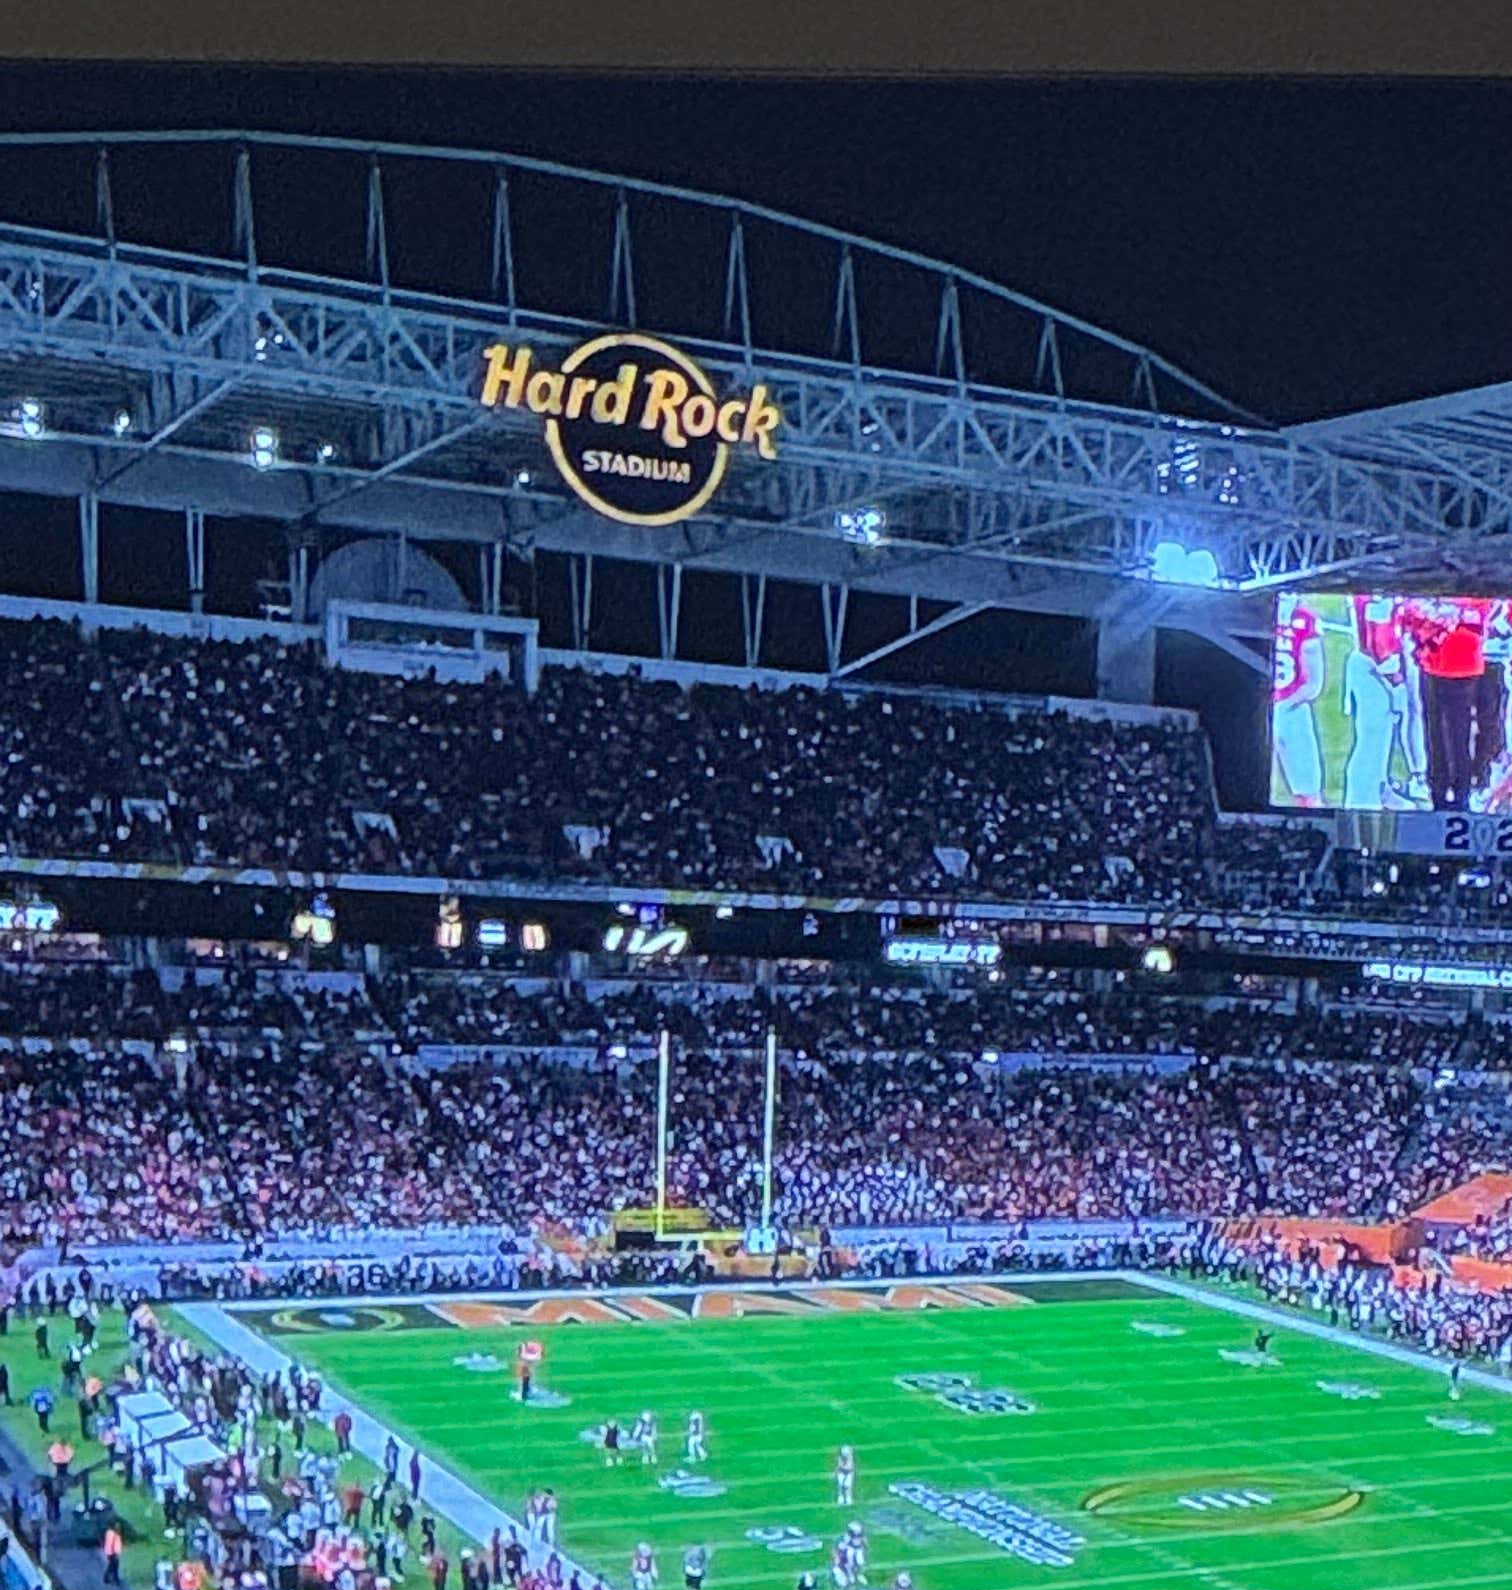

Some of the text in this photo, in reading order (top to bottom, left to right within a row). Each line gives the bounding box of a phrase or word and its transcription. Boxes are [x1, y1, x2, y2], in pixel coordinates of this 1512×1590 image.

[480, 344, 779, 460] Hard Rock
[582, 450, 691, 484] STADIUM
